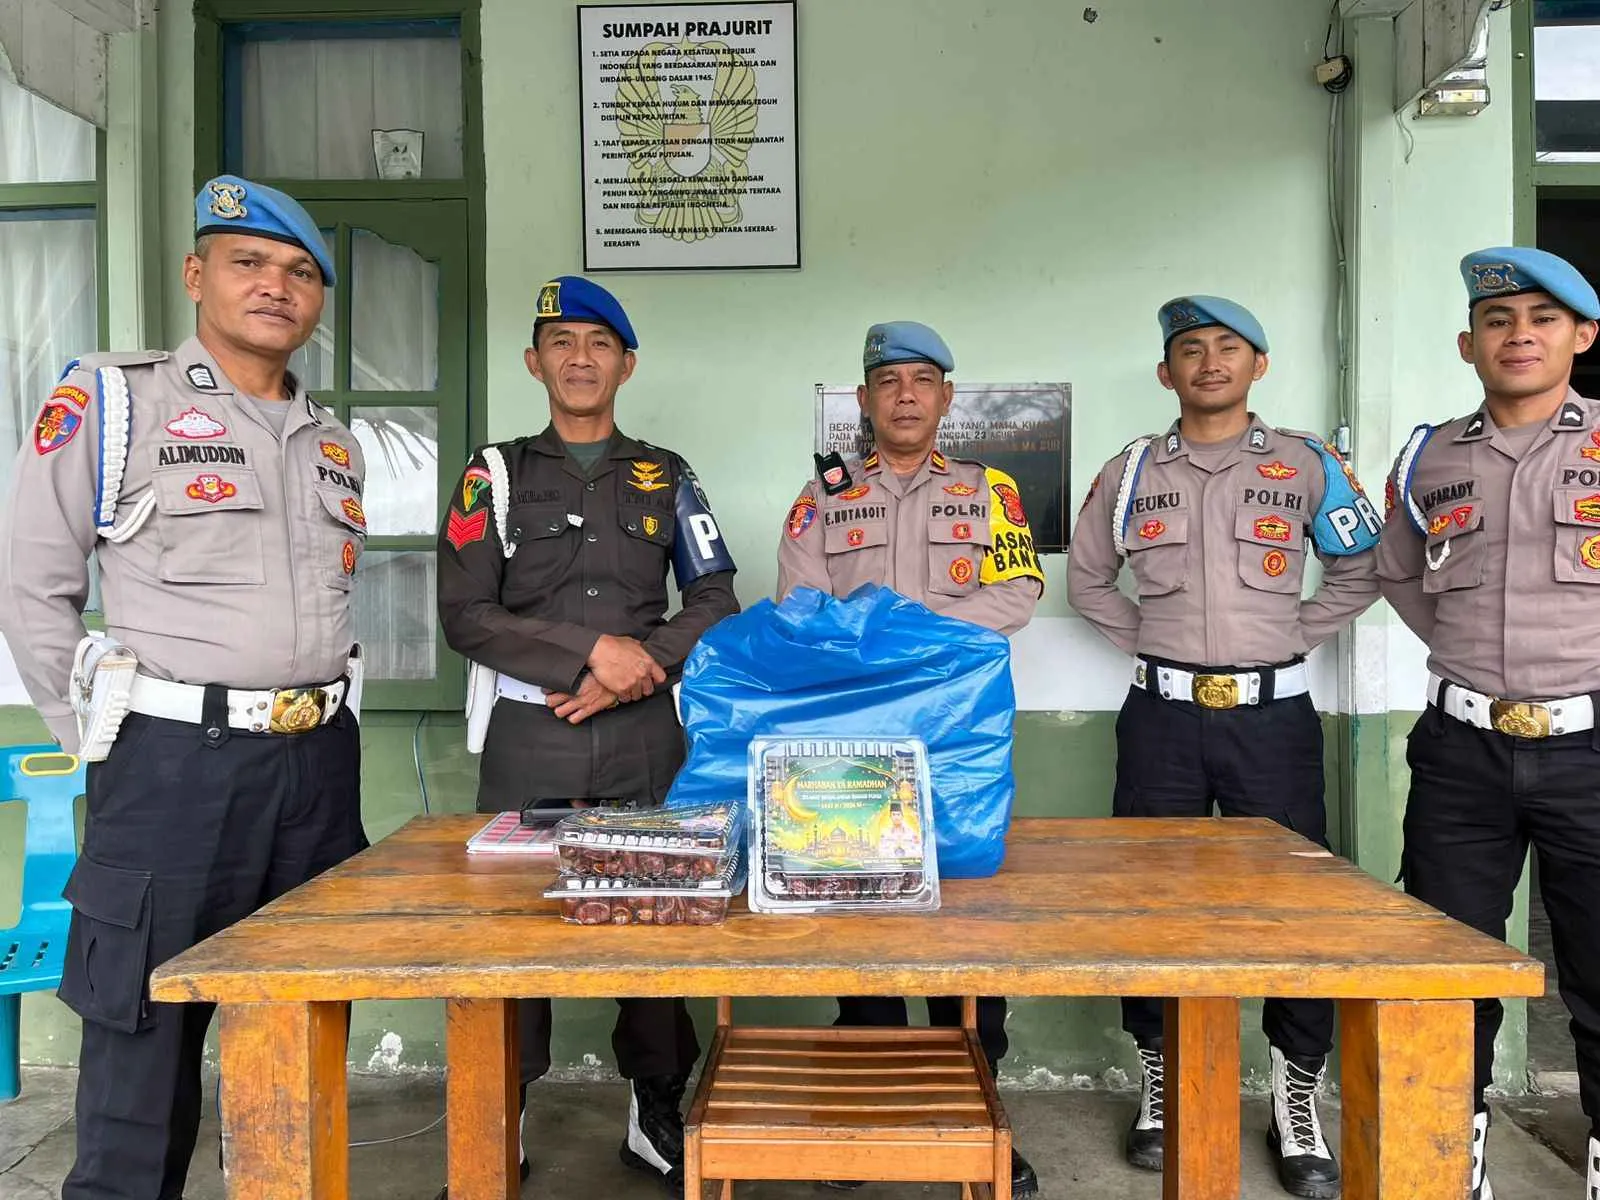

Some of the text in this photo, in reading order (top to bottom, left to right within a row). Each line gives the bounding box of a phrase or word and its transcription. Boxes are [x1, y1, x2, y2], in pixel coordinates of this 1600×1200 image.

[602, 20, 772, 38] SUMPAH PRAJURIT
[959, 421, 985, 430] YANG
[829, 432, 851, 441] PADA
[974, 431, 986, 439] 23
[159, 445, 246, 465] ALIMUDDIN
[316, 465, 361, 496] POLRI
[1562, 469, 1600, 486] PO
[1244, 488, 1302, 511] POLRI
[932, 504, 986, 518] POLRI
[688, 514, 719, 560] P
